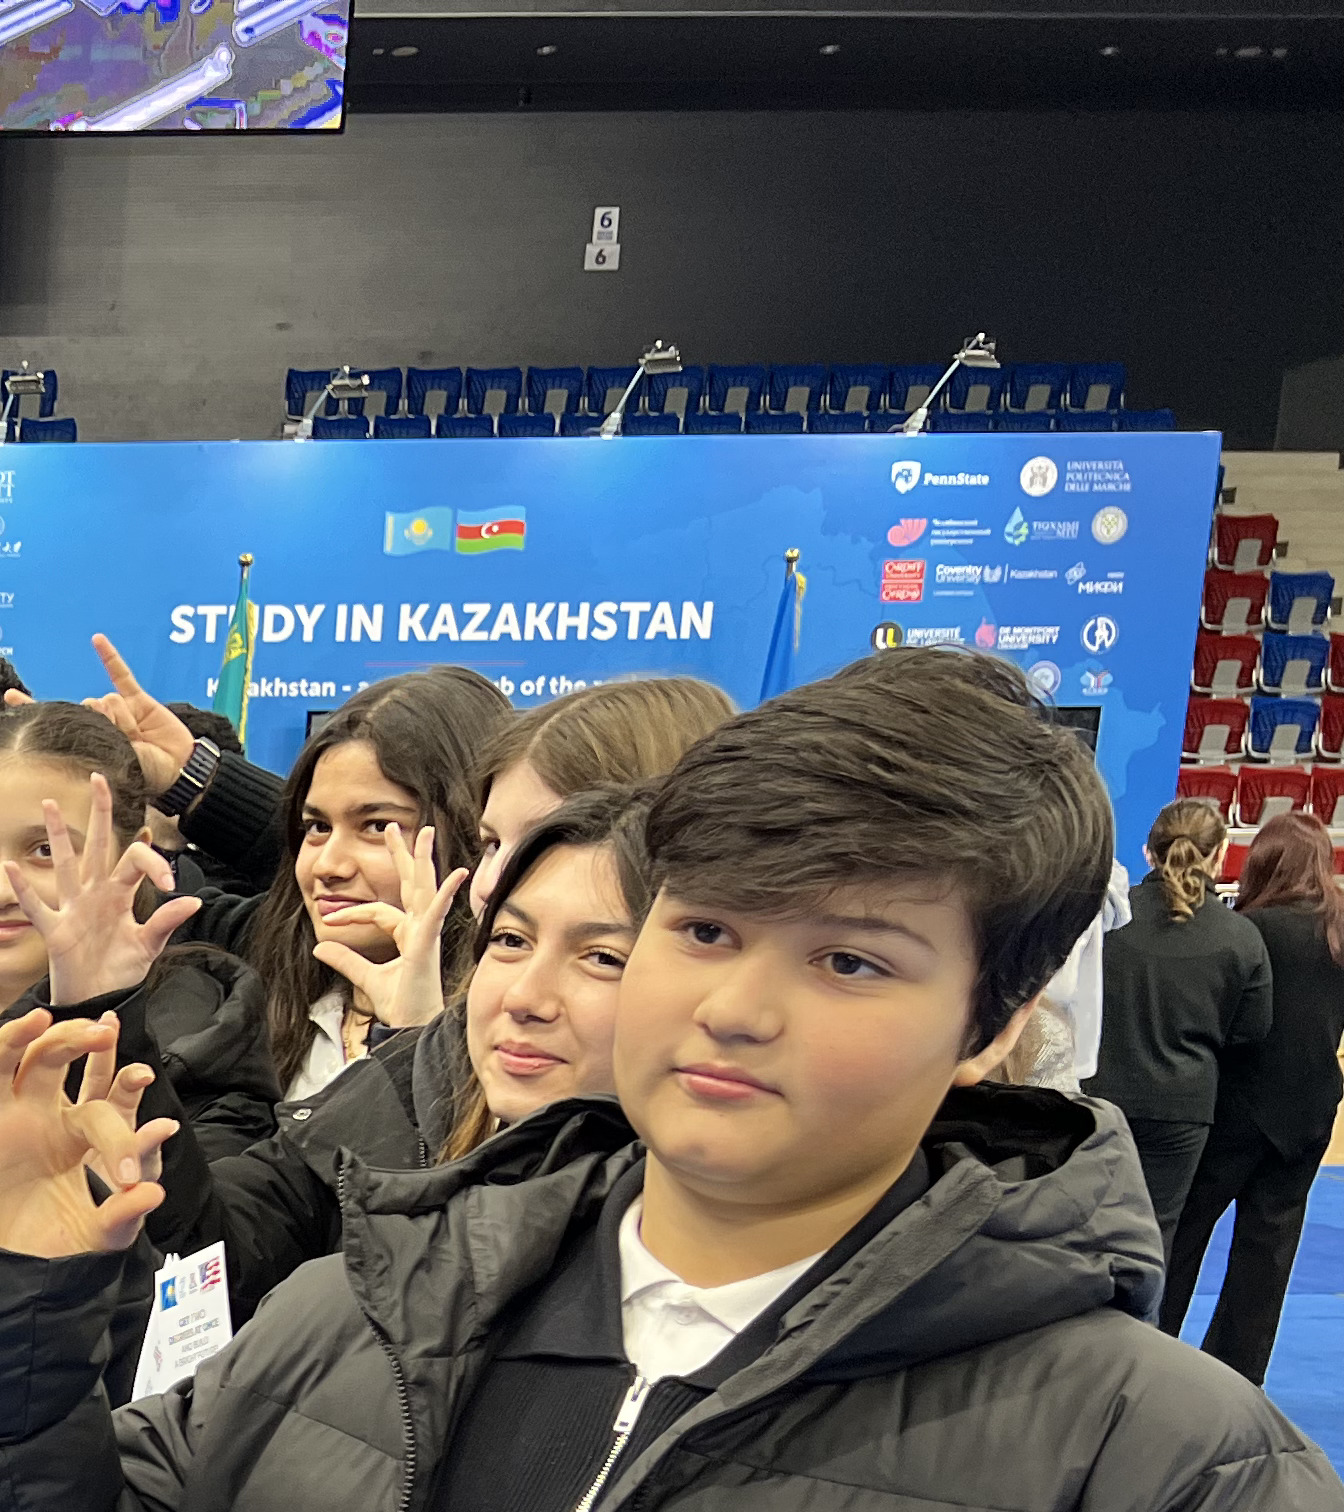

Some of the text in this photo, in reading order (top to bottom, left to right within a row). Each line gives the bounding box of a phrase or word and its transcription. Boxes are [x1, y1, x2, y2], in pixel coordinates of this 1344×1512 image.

[600, 211, 612, 228] 6
[595, 248, 606, 265] 6
[923, 472, 990, 487] PennState
[936, 564, 983, 577] Coventry
[169, 601, 714, 644] STDY IN KAZAKHSTAN
[206, 677, 336, 698] Kakhstan
[519, 675, 545, 696] of
